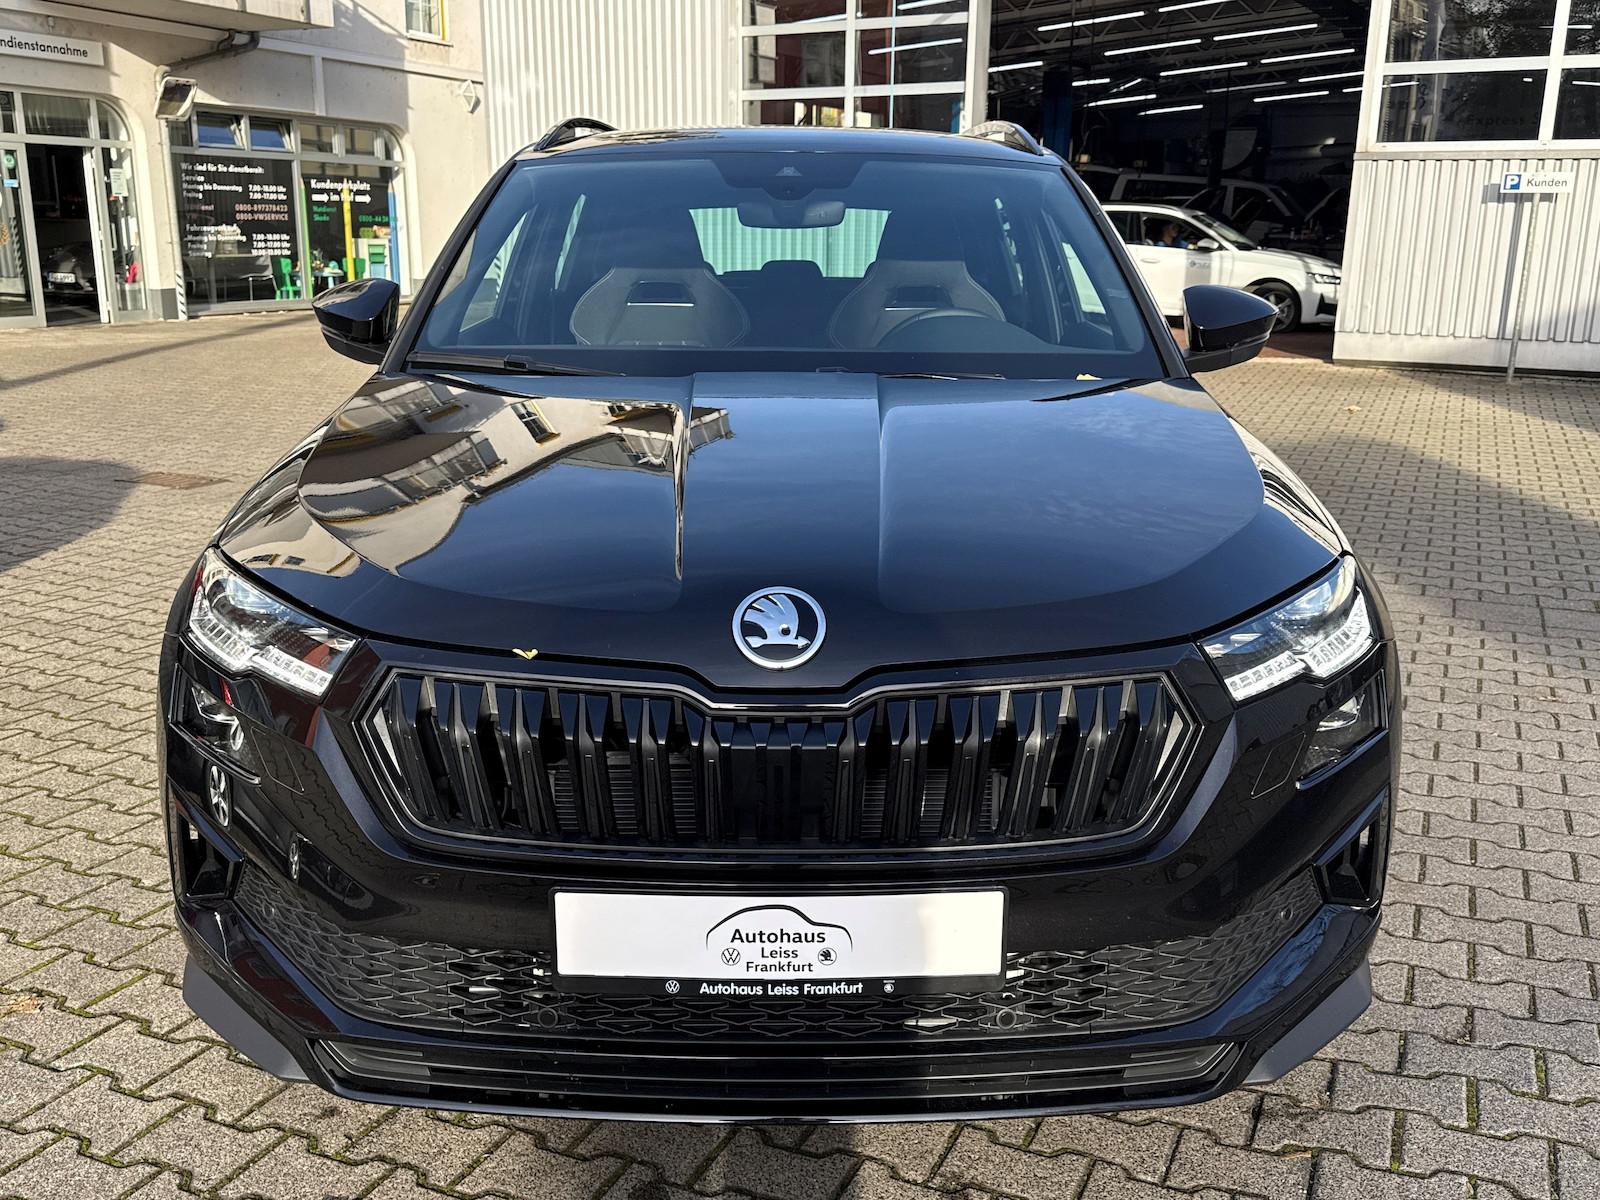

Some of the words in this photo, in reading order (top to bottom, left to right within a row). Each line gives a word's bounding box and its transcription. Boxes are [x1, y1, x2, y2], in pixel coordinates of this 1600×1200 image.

[180, 162, 193, 171] Wir
[193, 162, 207, 171] sind
[207, 162, 217, 172] für
[217, 163, 228, 172] Sie
[182, 173, 205, 182] Service
[203, 182, 213, 190] bis
[1526, 178, 1568, 188] Kunden
[276, 185, 287, 193] Uhr
[182, 190, 203, 200] Freitag
[277, 193, 288, 201] Uhr
[730, 928, 826, 944] Autohaus
[760, 946, 799, 959] Leiss
[745, 961, 814, 973] Frankfurt
[699, 982, 763, 996] Autohaus
[767, 983, 800, 996] Leiss
[803, 981, 864, 995] Frankfurt
